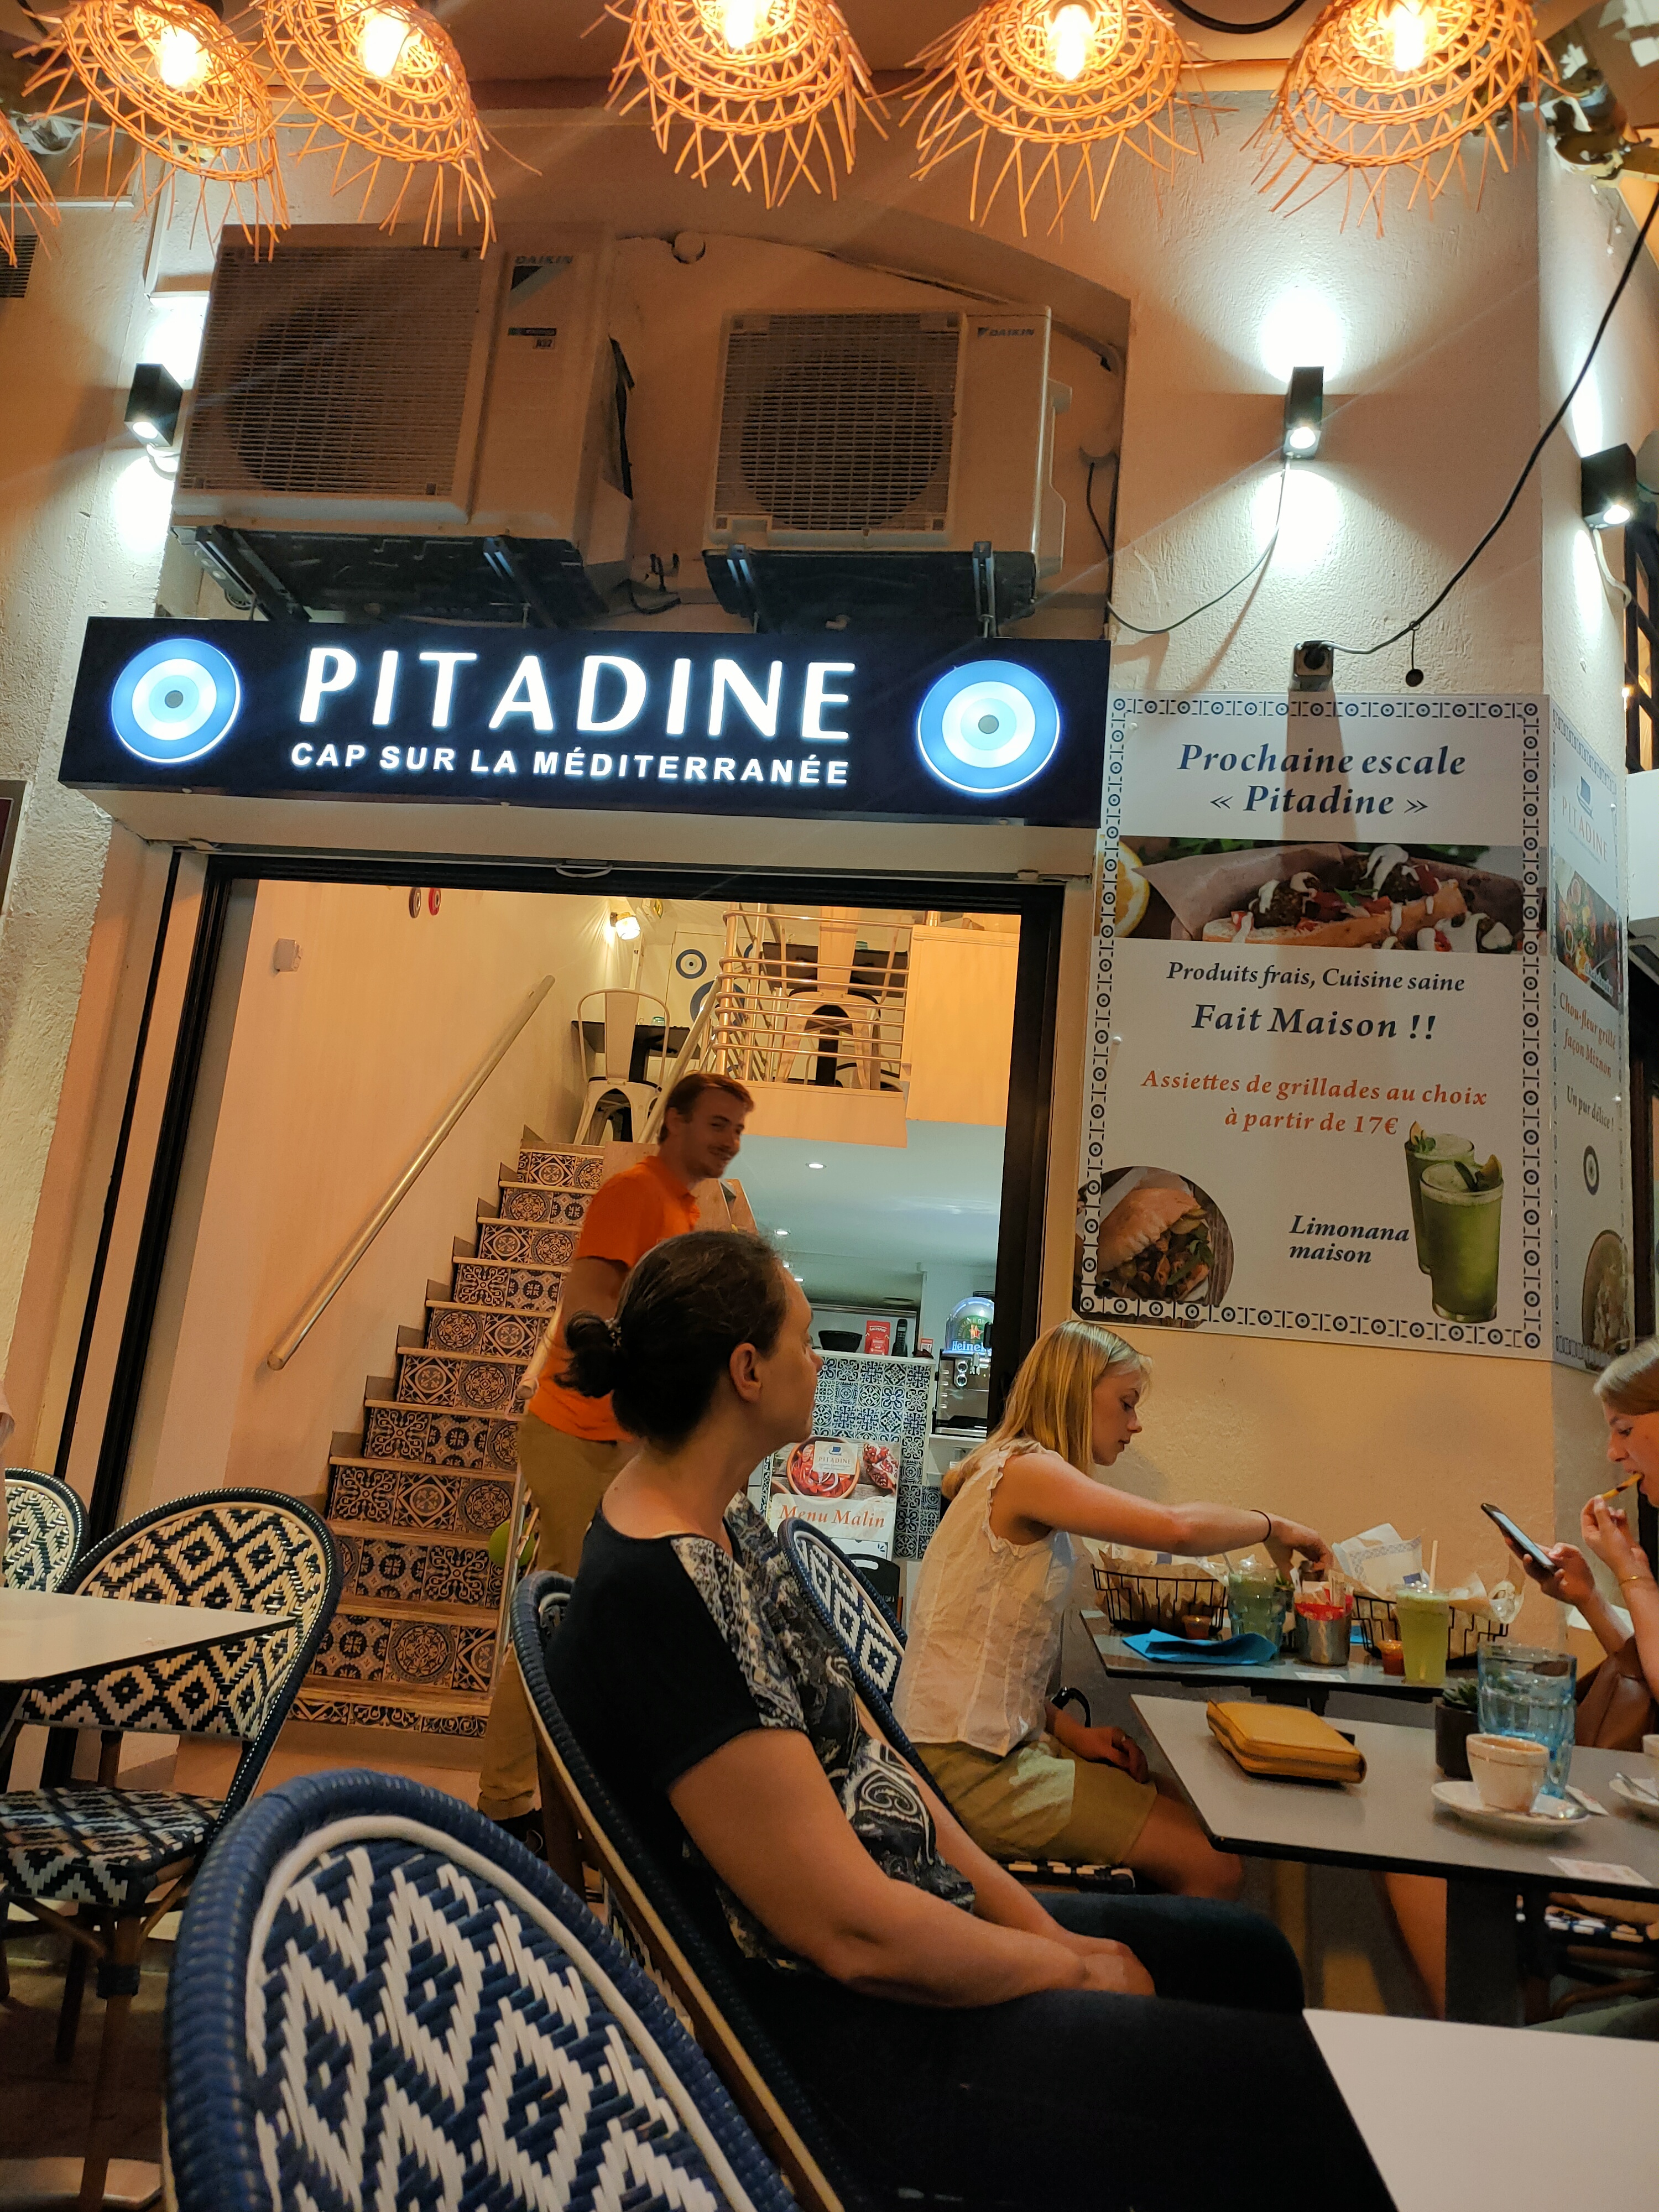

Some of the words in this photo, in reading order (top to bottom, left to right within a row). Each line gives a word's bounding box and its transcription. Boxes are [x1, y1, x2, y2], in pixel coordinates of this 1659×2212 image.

[299, 646, 855, 740] PITADINE
[291, 742, 366, 768] CAP
[379, 745, 457, 770] SUR
[471, 749, 517, 774] LA
[533, 747, 849, 786] MÉDITERRANÉE
[1177, 743, 1354, 774] Prochaine
[1361, 745, 1466, 775] escale
[1243, 784, 1395, 815] Pitadine
[1562, 795, 1608, 863] PITADINE
[1166, 961, 1258, 983] Produits
[1258, 966, 1316, 989] frais,
[1322, 967, 1404, 990] Cuisine
[1407, 973, 1465, 992] saine
[1191, 1004, 1262, 1032] Fait
[1267, 1006, 1397, 1039] Maison
[1563, 1028, 1585, 1058] façon
[1140, 1069, 1240, 1092] Assiettes
[1246, 1074, 1272, 1094] de
[1276, 1077, 1380, 1100] grillades
[1386, 1086, 1416, 1102] au
[1421, 1084, 1488, 1106] choix
[1567, 1084, 1577, 1108] Un
[1578, 1097, 1591, 1115] pur
[1224, 1107, 1238, 1126] à
[1241, 1111, 1314, 1133] partir
[1319, 1112, 1346, 1133] de
[1354, 1115, 1399, 1135] 17€
[1288, 1214, 1410, 1241] Limonana
[1288, 1243, 1372, 1264] maison
[952, 1340, 986, 1352] Heinek
[818, 1456, 851, 1464] PITADINE
[778, 1504, 828, 1523] Menu
[831, 1509, 885, 1528] Malin
